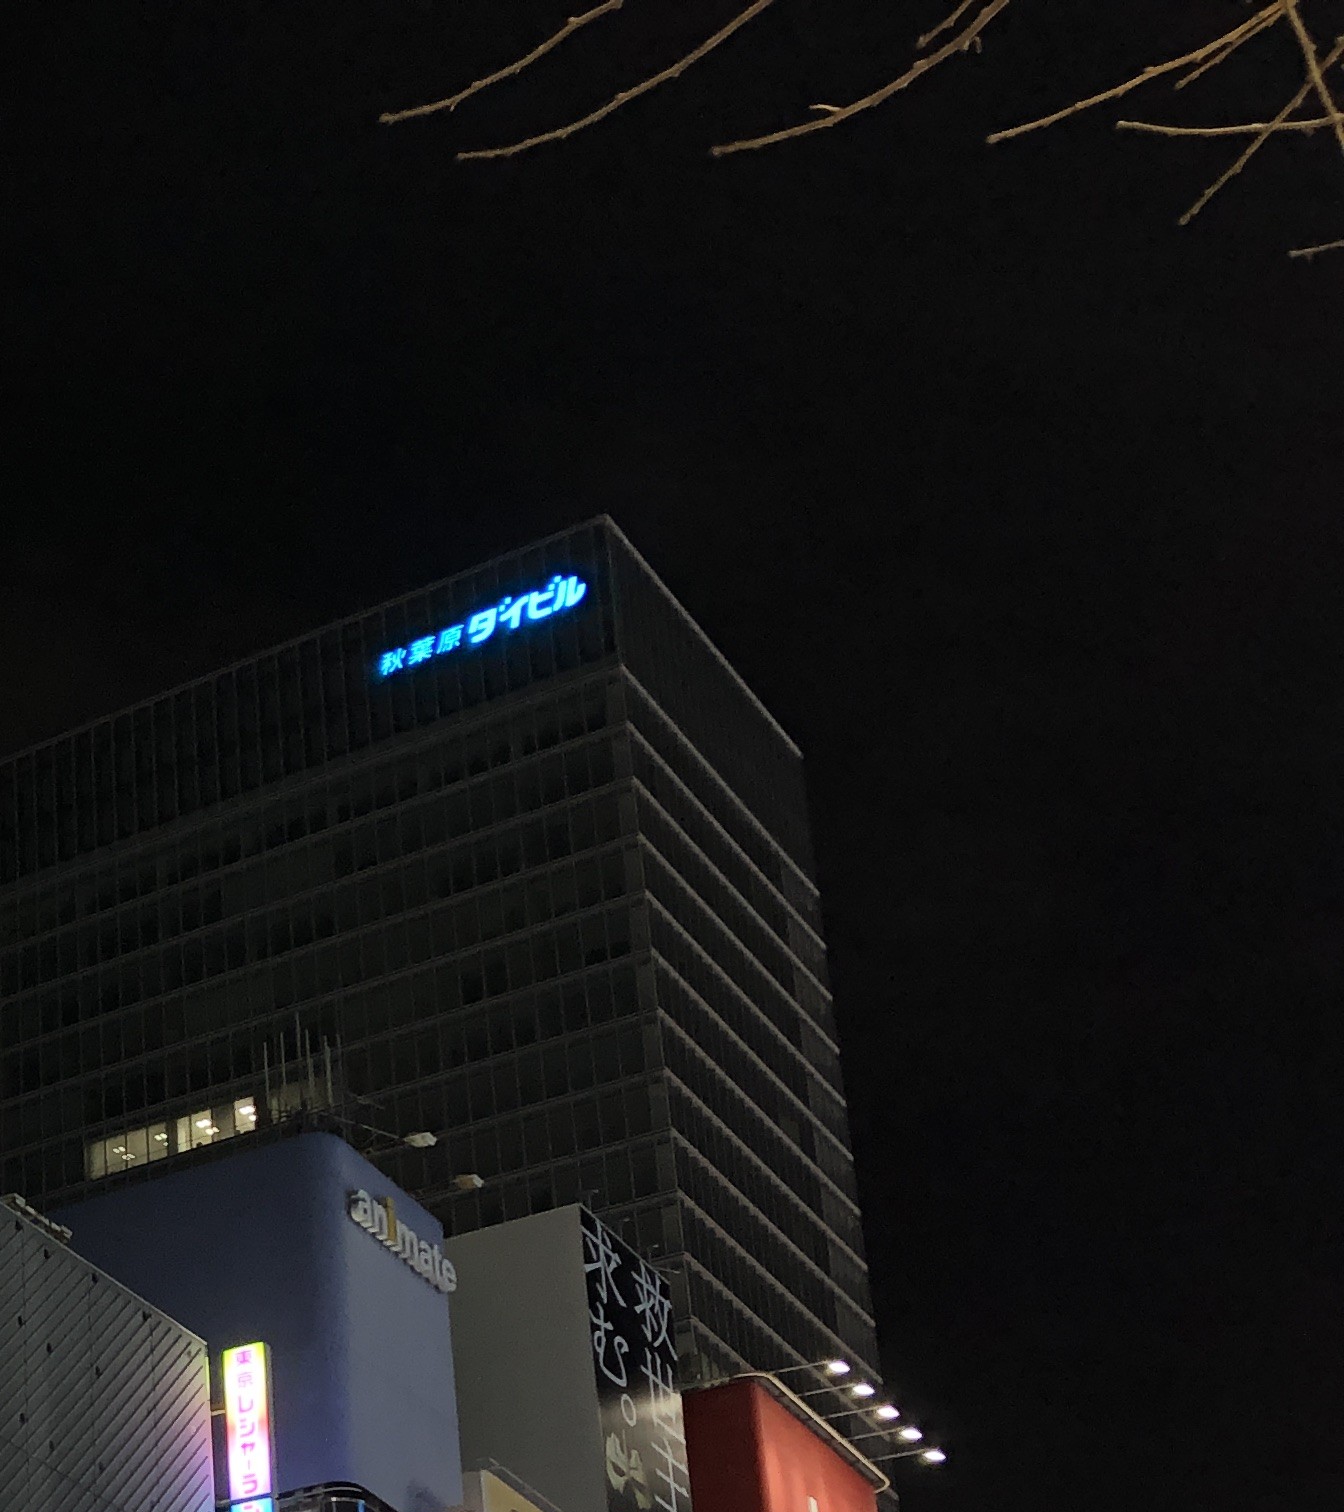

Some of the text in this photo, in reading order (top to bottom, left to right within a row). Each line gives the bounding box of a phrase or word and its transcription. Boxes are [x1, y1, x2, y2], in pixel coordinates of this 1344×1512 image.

[379, 574, 586, 676] 秋葉原ダイビル
[349, 1189, 458, 1294] animate
